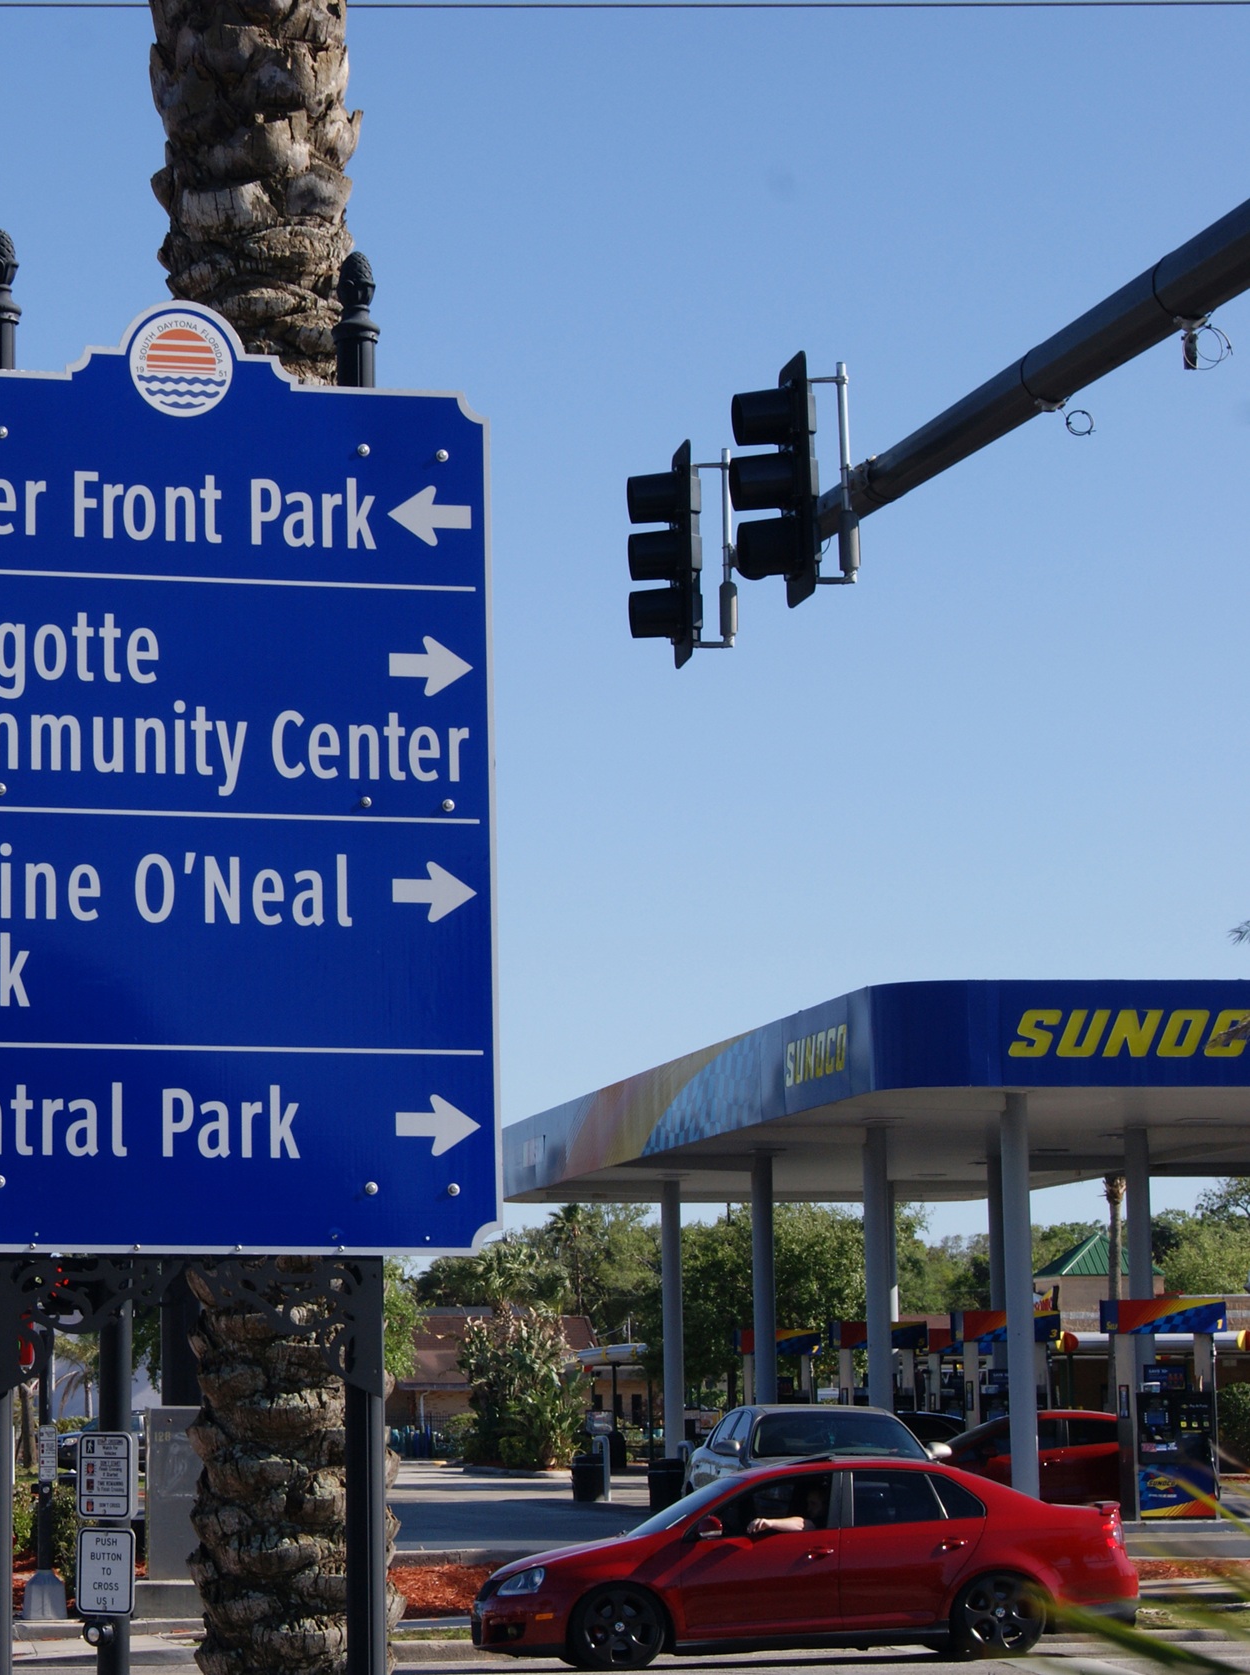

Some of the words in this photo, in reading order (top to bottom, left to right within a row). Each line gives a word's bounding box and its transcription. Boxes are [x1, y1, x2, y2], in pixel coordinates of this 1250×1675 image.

[139, 332, 156, 361] SOUTH
[157, 320, 198, 333] DAYTONA
[201, 329, 223, 364] FLORIDA
[136, 366, 145, 374] 19
[74, 470, 222, 544] Front
[250, 477, 377, 550] Park
[271, 709, 470, 782] Center
[134, 852, 353, 927] O'Neal
[785, 1024, 847, 1088] SUNOCO
[162, 1084, 301, 1159] Park
[1216, 1318, 1223, 1330] 1
[1049, 1328, 1058, 1338] 3
[95, 1538, 117, 1546] PUSH
[90, 1552, 122, 1561] BUTTON
[102, 1567, 111, 1576] TO
[93, 1582, 119, 1591] CROSS
[96, 1597, 107, 1605] US
